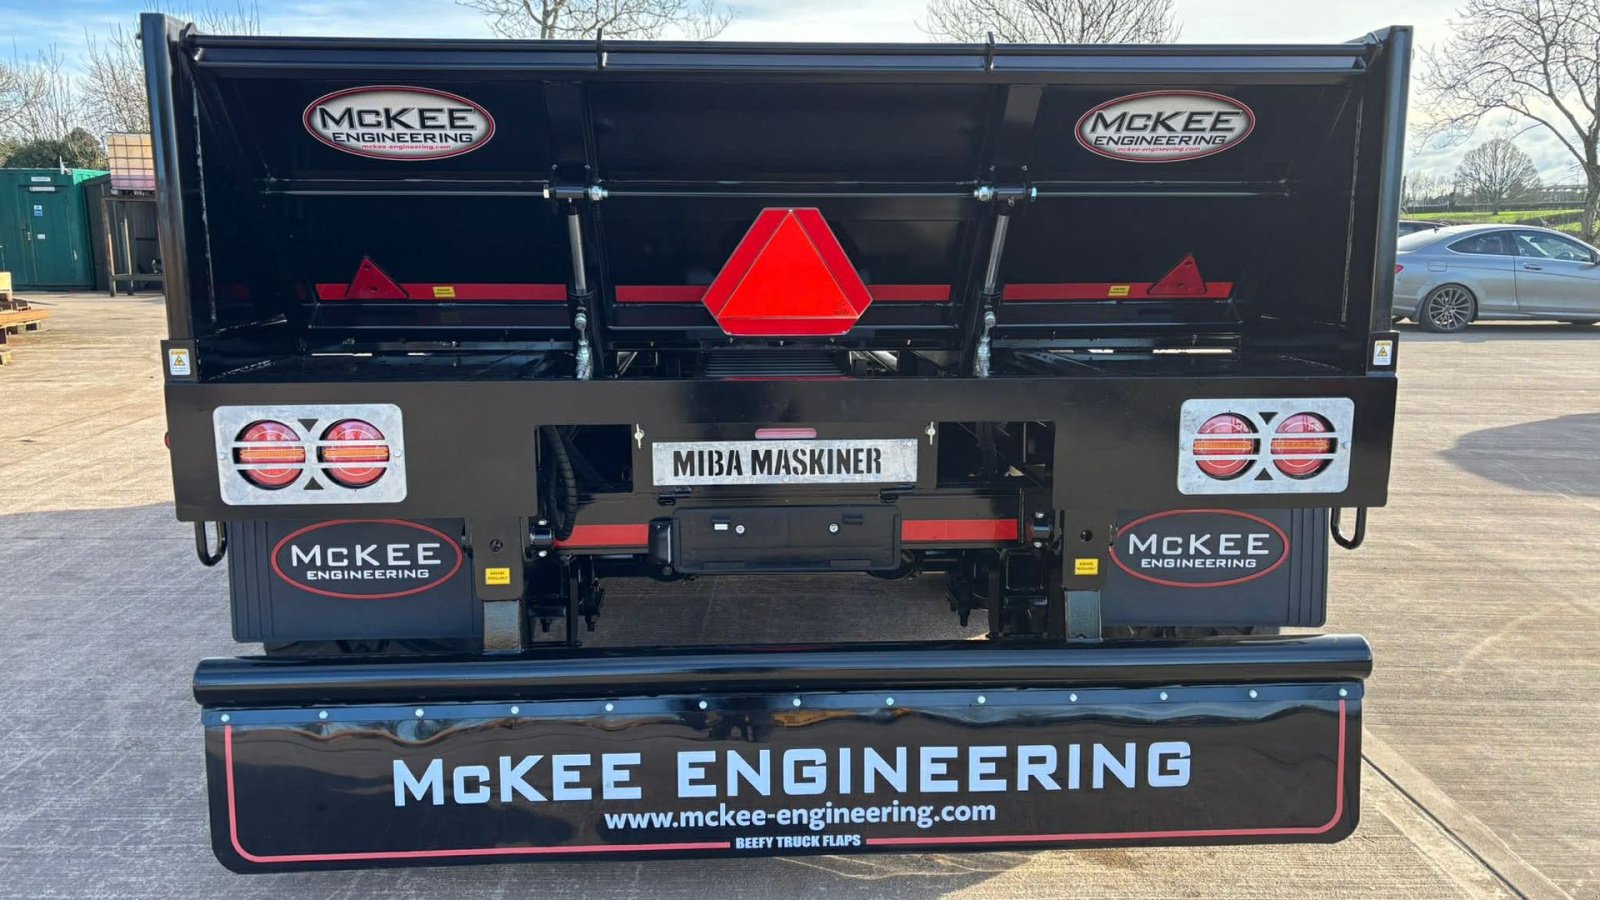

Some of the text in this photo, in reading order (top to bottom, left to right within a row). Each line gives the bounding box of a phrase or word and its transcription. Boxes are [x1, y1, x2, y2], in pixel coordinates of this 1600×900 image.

[332, 132, 473, 144] ENGINEERING
[1093, 135, 1228, 146] ENGINEERING
[673, 448, 882, 477] MIBA MASKINER
[1128, 533, 1270, 555] McKEE
[291, 543, 442, 567] McKEE
[1141, 558, 1257, 568] ENGINEERING
[306, 569, 430, 580] ENGINEERING
[393, 741, 1191, 806] McKEE ENGINEERING
[604, 800, 996, 830] www.mckee-engineering.com
[735, 834, 861, 849] BEEFY TRUCK FLAPS
